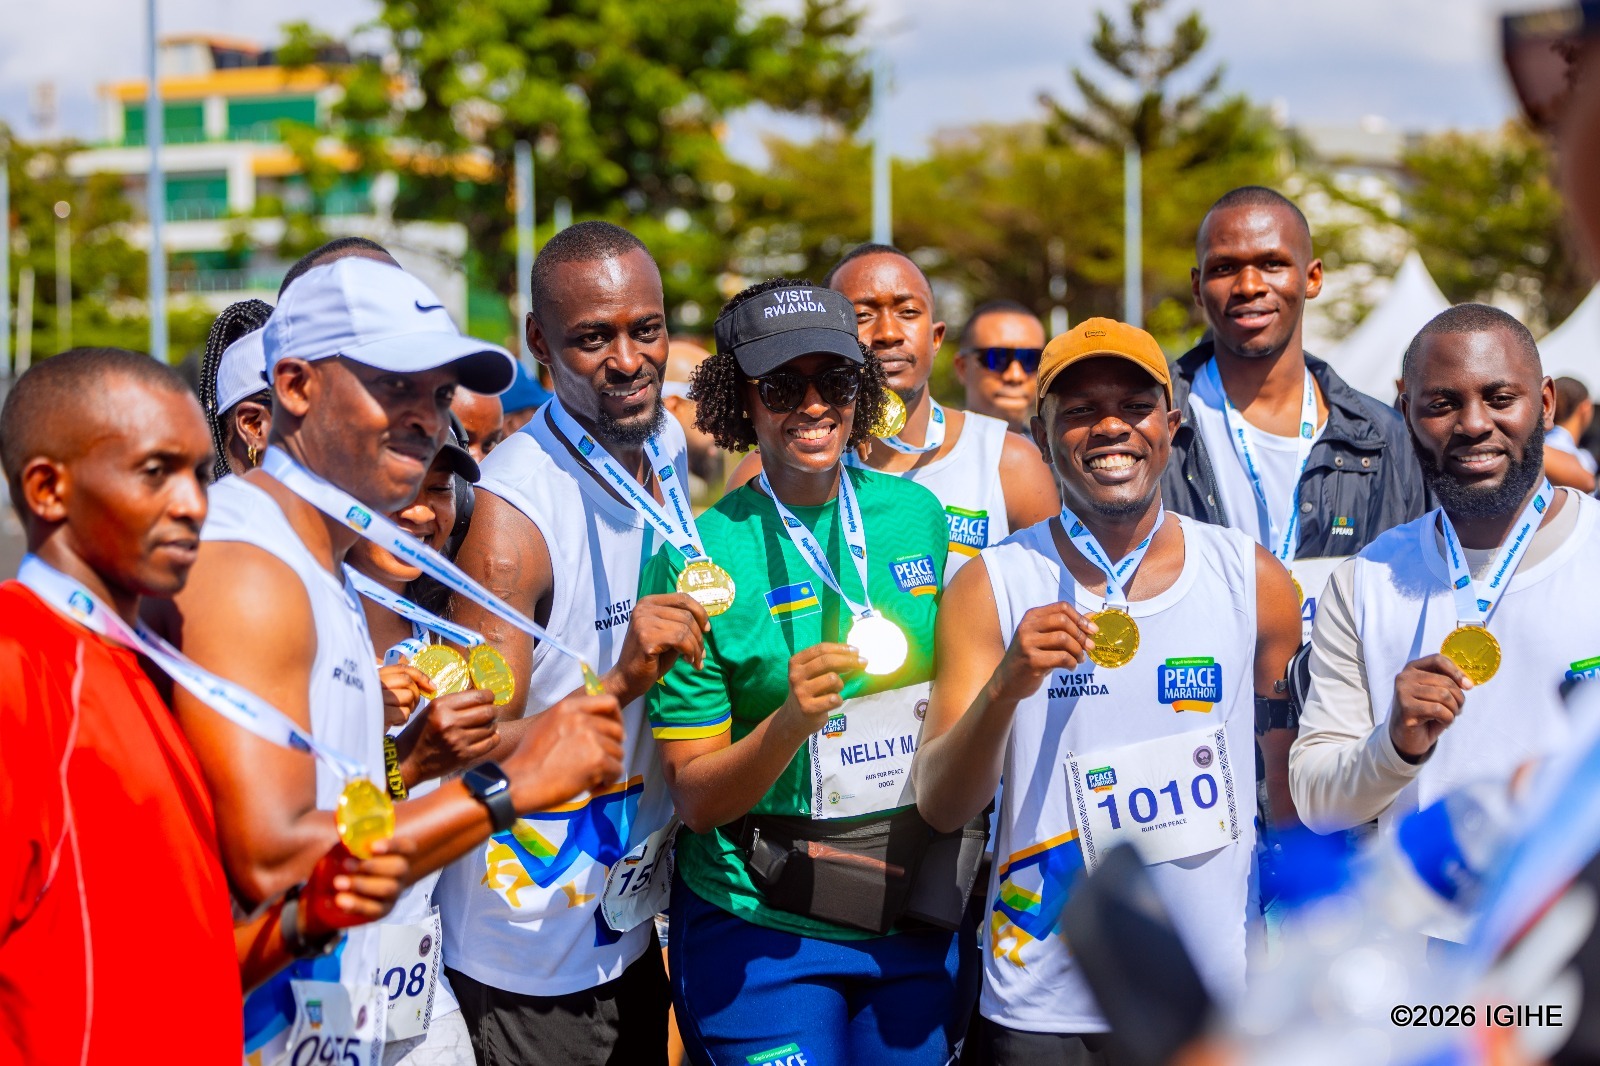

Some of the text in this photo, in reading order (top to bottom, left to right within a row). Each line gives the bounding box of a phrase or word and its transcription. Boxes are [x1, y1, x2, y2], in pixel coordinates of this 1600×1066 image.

[774, 290, 812, 303] VISIT
[764, 302, 826, 318] RWANDA
[604, 464, 673, 534] Kigali International Peace Marathon
[669, 488, 677, 499] Kigali
[673, 498, 684, 522] International
[1490, 524, 1530, 588] Kigali International Peace Marathon
[894, 559, 932, 580] PEACE
[900, 574, 936, 589] MARATHON
[605, 599, 631, 616] VISIT
[595, 611, 632, 630] RWAN
[1059, 673, 1095, 686] VISIT
[1165, 668, 1215, 688] PEACE
[1048, 685, 1109, 699] RWANDA
[1165, 688, 1216, 699] MARATHON
[841, 738, 895, 766] NELLY
[888, 768, 904, 776] PEACE
[1089, 771, 1113, 783] PEACE
[878, 780, 894, 788] 0002
[1098, 774, 1218, 830] 1010
[1168, 818, 1187, 827] PEACE
